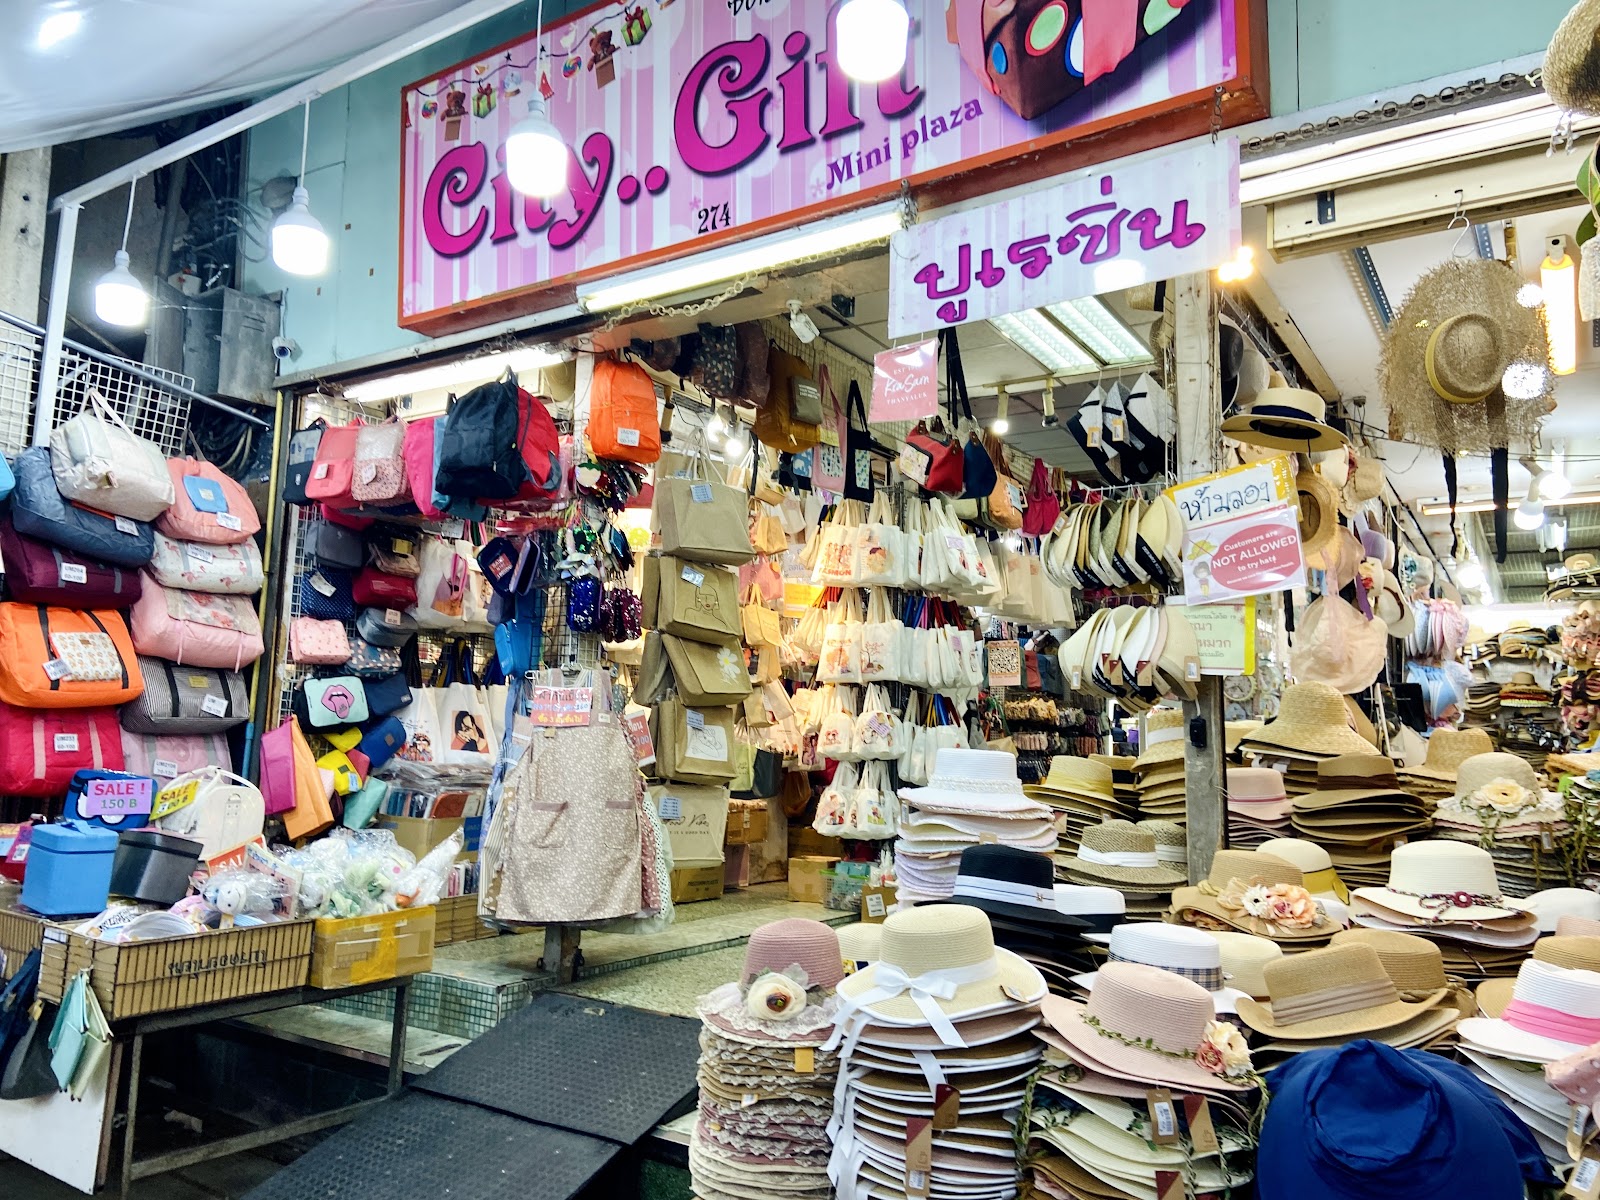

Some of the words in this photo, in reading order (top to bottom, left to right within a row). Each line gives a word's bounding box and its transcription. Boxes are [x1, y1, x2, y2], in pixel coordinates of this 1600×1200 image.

[826, 137, 892, 190] Mini
[900, 98, 984, 160] plaza
[696, 202, 732, 234] 274
[914, 175, 1205, 323] ปูเรซิ่น
[1180, 481, 1270, 522] ห้ามลอง
[1212, 553, 1237, 569] NOT
[1239, 535, 1297, 561] ALLOWED
[1223, 535, 1265, 551] Customers
[1265, 530, 1279, 539] are
[1247, 561, 1259, 569] try
[94, 783, 135, 796] SALE
[159, 784, 191, 803] SALE
[101, 799, 125, 809] 150
[129, 798, 137, 808] B
